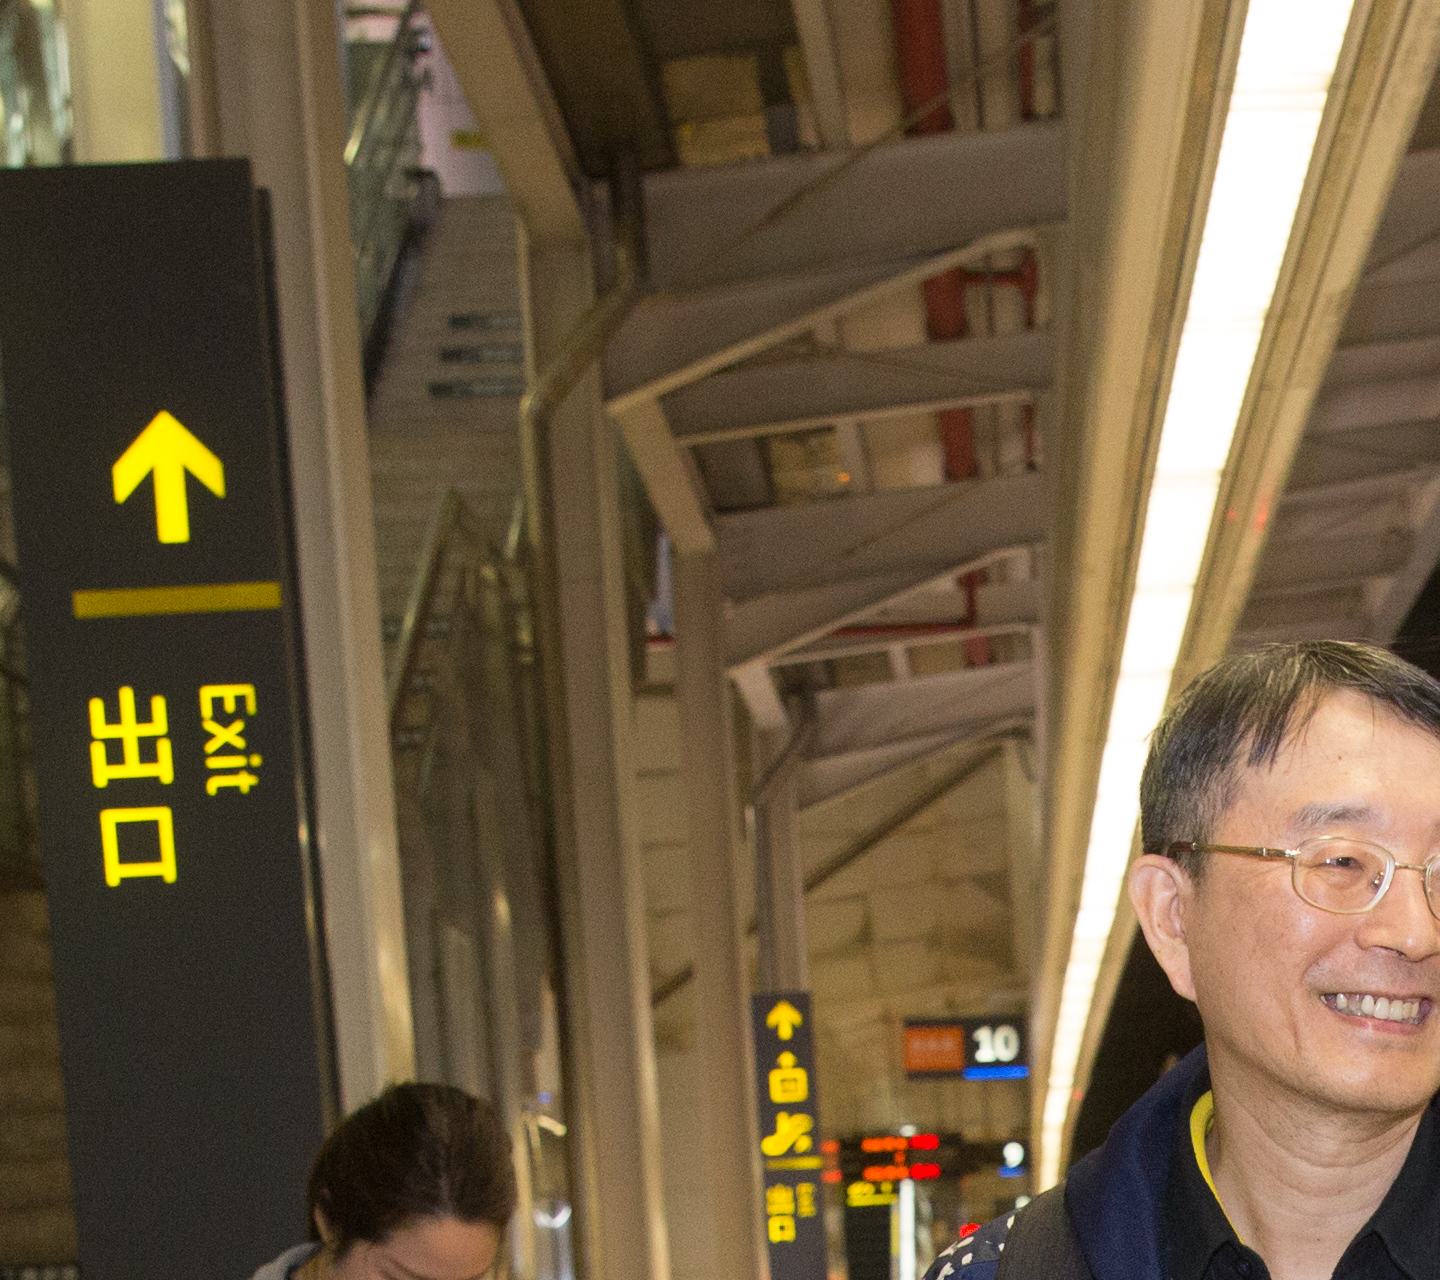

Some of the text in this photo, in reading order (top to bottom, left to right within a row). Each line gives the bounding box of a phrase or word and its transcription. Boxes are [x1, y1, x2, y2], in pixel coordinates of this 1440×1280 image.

[88, 685, 178, 888] 出口
[198, 683, 263, 797] Exit
[972, 1024, 1020, 1063] 10
